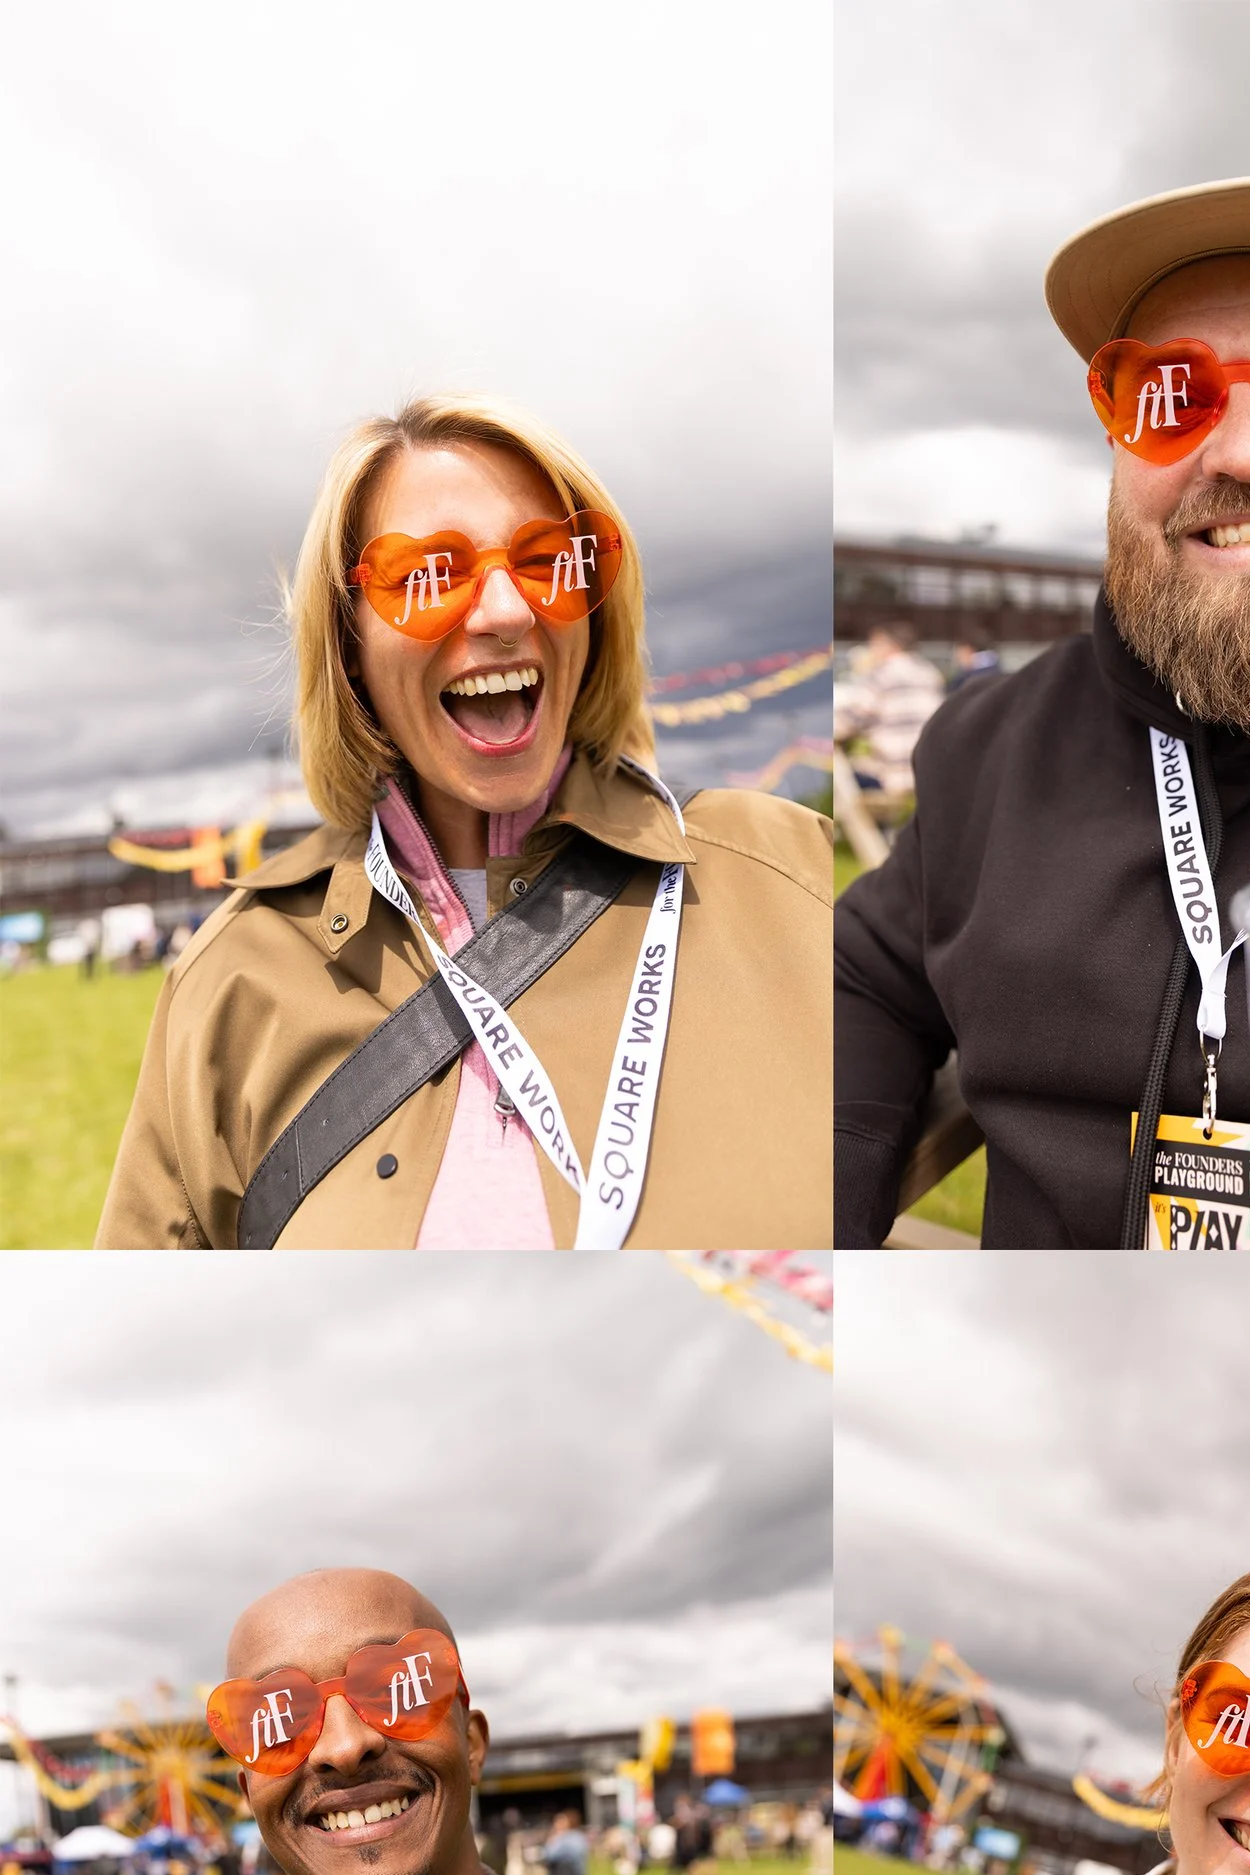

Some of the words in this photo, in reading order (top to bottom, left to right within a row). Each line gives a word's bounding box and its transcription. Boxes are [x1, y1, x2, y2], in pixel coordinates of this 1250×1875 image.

[1160, 734, 1188, 818] WORKS
[660, 893, 676, 914] for
[664, 876, 677, 892] the
[1170, 821, 1213, 944] SQUARE
[437, 955, 524, 1071] SQUARE
[518, 1070, 580, 1187] WORK
[600, 1055, 648, 1210] SQUARE
[627, 943, 667, 1044] WORKS
[1154, 1166, 1244, 1196] PLAYGROUND
[1155, 1151, 1172, 1166] the
[1174, 1152, 1244, 1176] FOUNDERS
